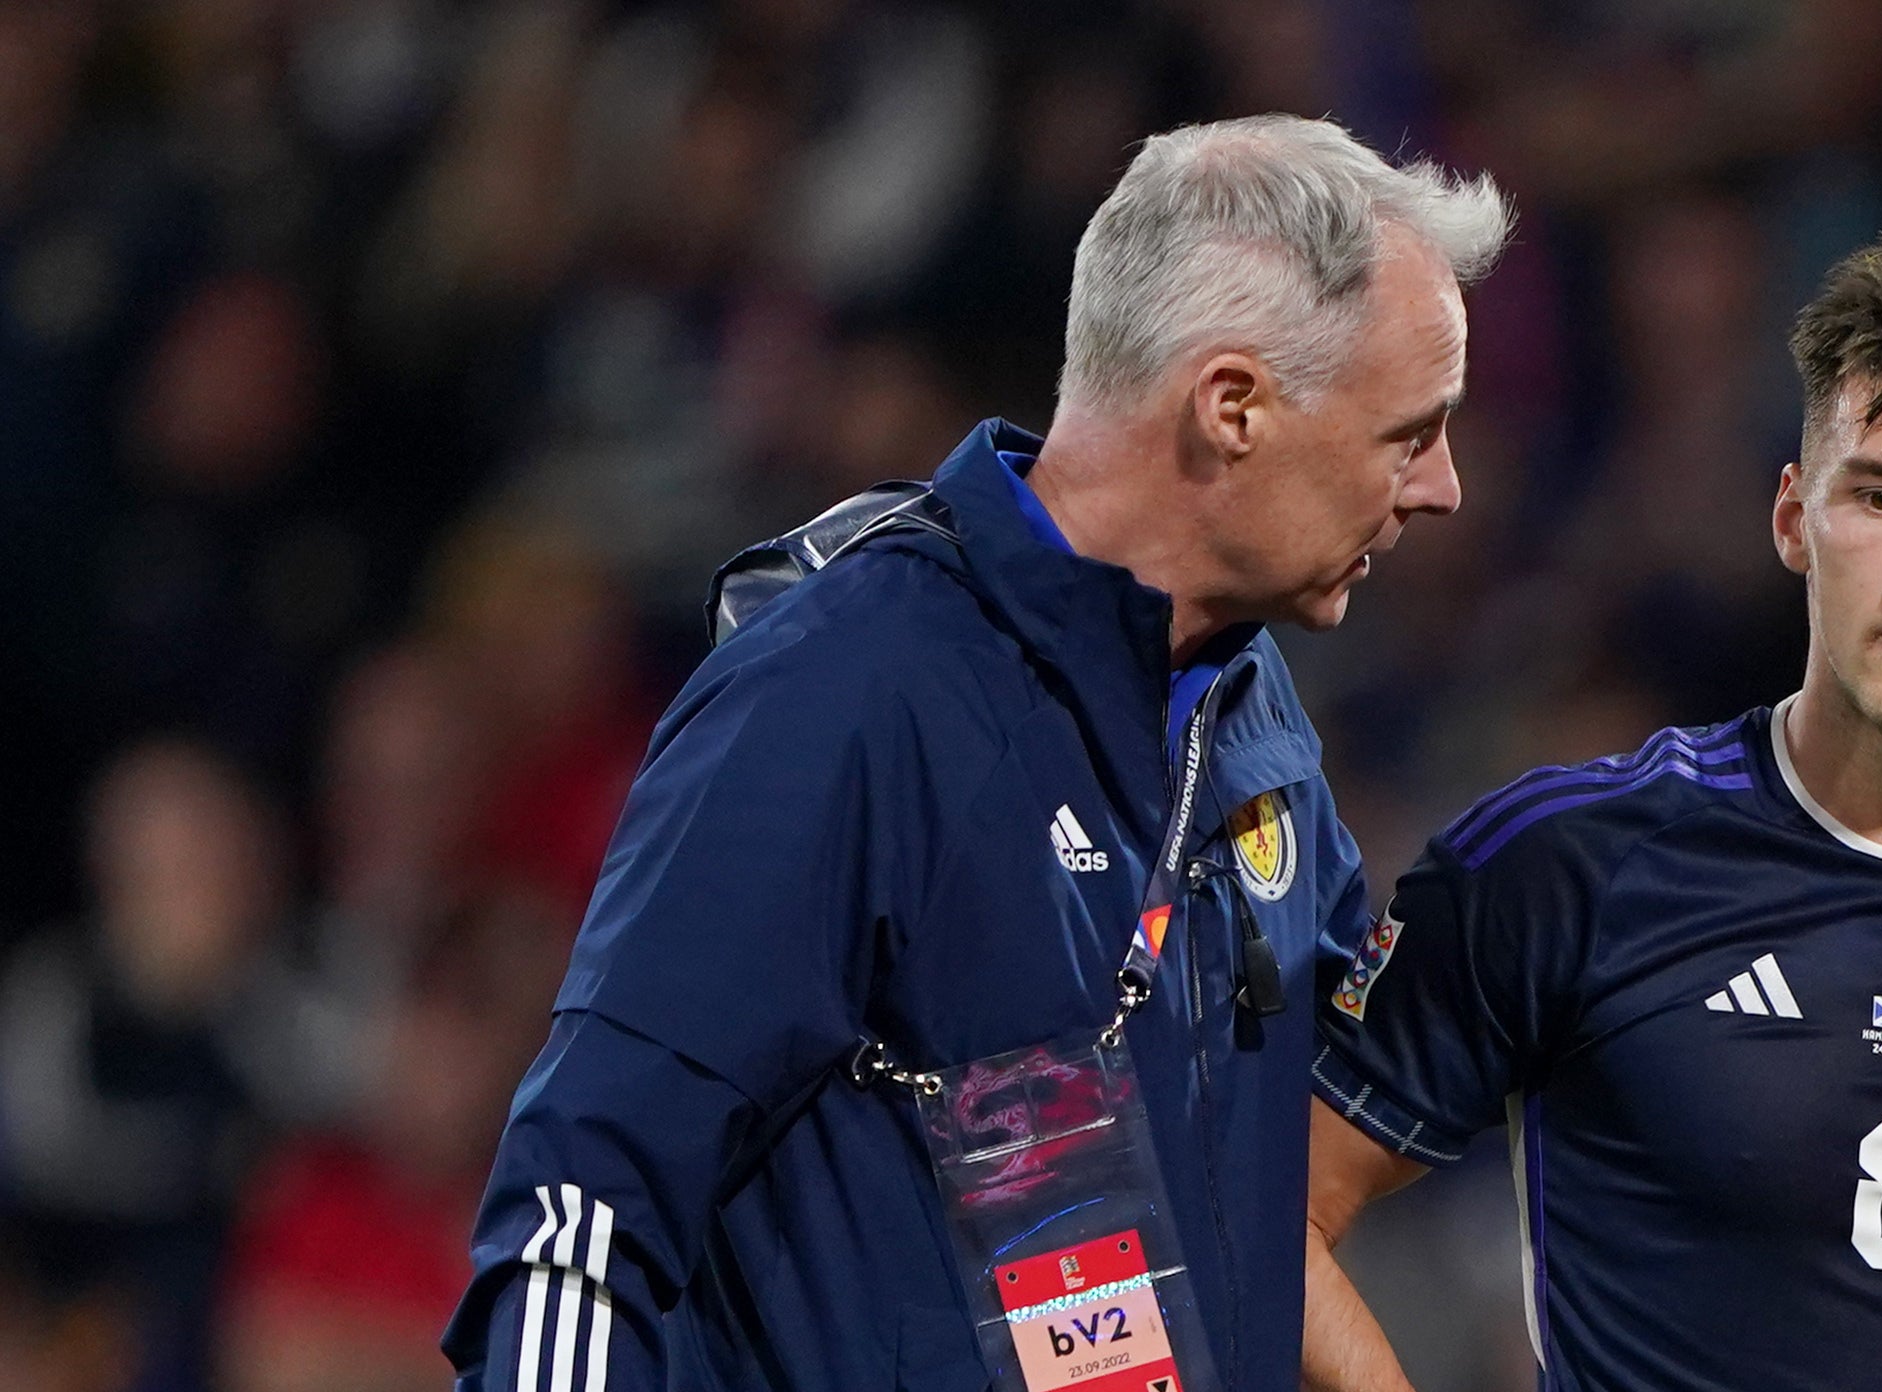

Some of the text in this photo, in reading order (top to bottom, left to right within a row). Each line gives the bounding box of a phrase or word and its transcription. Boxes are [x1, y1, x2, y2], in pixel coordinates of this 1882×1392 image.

[1166, 833, 1183, 872] UEFA
[1177, 769, 1198, 836] NATIONS
[1047, 1306, 1132, 1358] bV2
[1068, 1352, 1132, 1378] 23.09.2022
